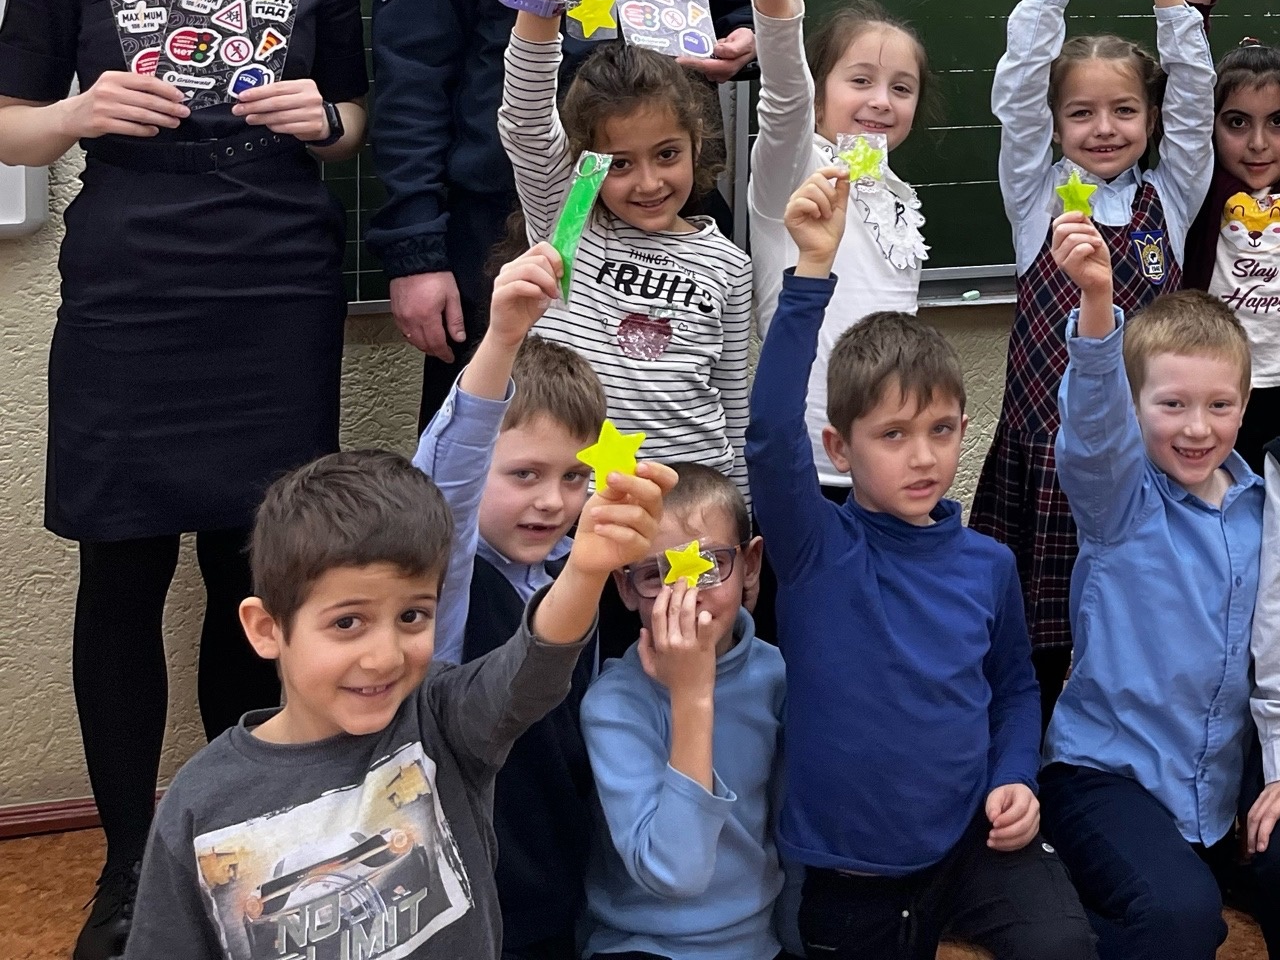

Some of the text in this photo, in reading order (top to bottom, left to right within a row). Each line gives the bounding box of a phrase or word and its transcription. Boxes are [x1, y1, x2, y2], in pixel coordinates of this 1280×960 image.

[256, 6, 286, 19] ПДД
[629, 249, 670, 266] THINGS
[1232, 258, 1279, 282] Stay
